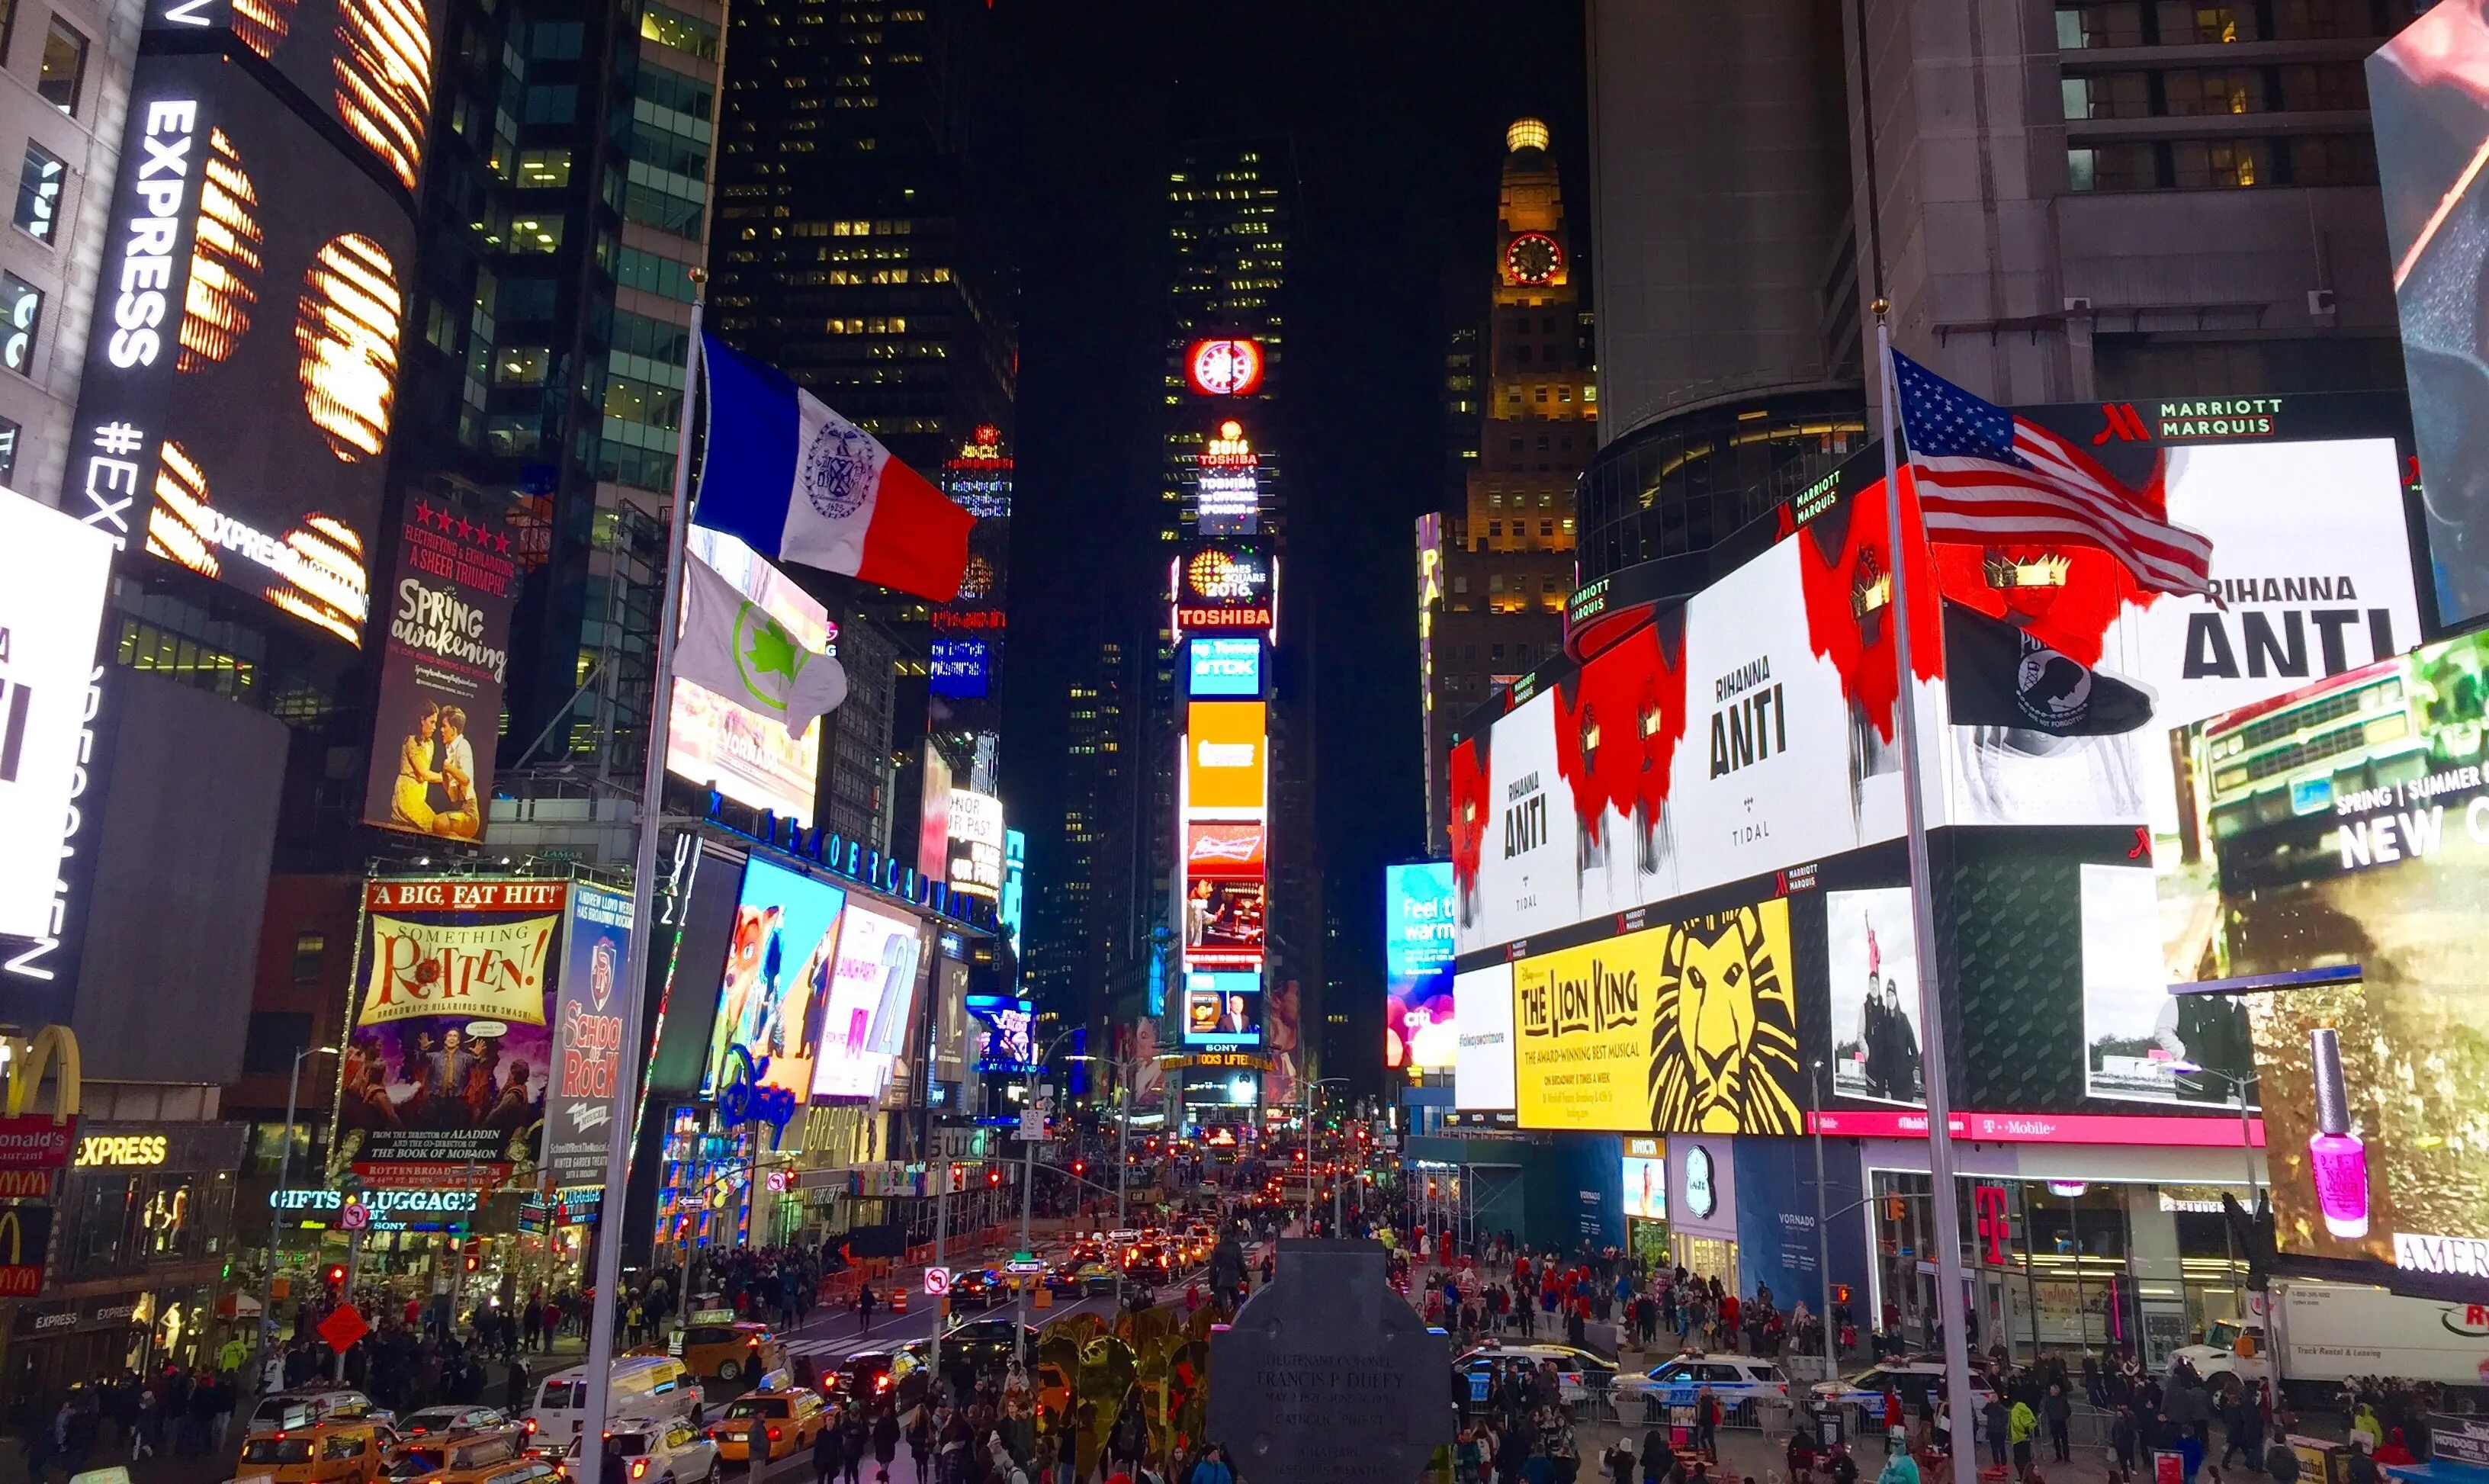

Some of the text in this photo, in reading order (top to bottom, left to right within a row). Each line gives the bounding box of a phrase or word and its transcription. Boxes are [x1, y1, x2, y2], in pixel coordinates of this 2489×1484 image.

[108, 100, 197, 368] EXPRESS
[2161, 399, 2282, 417] MARRIOTT
[2163, 418, 2271, 436] MARQUIS
[1209, 440, 1248, 455] 2016
[1200, 455, 1257, 464] TOSHIBA
[1200, 477, 1256, 490] TOSHIBA
[1797, 471, 1840, 508] MARRIOTT
[1797, 491, 1835, 524] MARQUIS
[409, 546, 417, 567] A
[420, 549, 453, 579] SHEER
[1225, 573, 1266, 582] SQUARE
[1570, 579, 1610, 609] MARRIOTT
[2205, 576, 2358, 603] RIHANNA
[398, 577, 483, 638] SPRING
[1571, 598, 1604, 624] MARQUIS
[1179, 609, 1270, 625] TOSHIBA
[391, 618, 507, 683] awakening
[2182, 608, 2396, 680] ANTI
[1716, 654, 1771, 704] RIHANNA
[1710, 682, 1786, 781] ANTI
[1508, 770, 1540, 803] RIHANNA
[2336, 766, 2481, 816] SPRING SUMMER
[950, 796, 979, 815] ONOR
[1505, 792, 1546, 860] ANTI
[1732, 821, 1770, 847] TIDAL
[2339, 805, 2443, 869] NEW
[544, 850, 583, 859] LAMAR
[1789, 863, 1818, 879] MARRIOTT
[849, 841, 974, 923] BROADWAY
[1790, 877, 1815, 891] MARQUIS
[452, 885, 497, 903] FAT
[1516, 894, 1537, 911] TIDAL
[602, 897, 617, 911] LLOYD
[618, 901, 633, 914] WEBB
[1404, 898, 1437, 919] Feel
[577, 907, 615, 925] HAS BROADWAY
[398, 925, 528, 944] SOMETHING
[1405, 923, 1454, 941] warm
[368, 929, 548, 1011] ROTTEN!
[1521, 959, 1638, 1038] THE LION KING
[377, 1003, 531, 1020] BROADWAY'S HILARIOUS NEW SMASH!
[562, 999, 622, 1050] SCHOO
[589, 1048, 601, 1060] OF
[1202, 1054, 1249, 1065] OCKS LIFTE
[1525, 1042, 1640, 1065] THE AWARD-WINNING BEST MUSICAL
[560, 1049, 618, 1098] ROCK
[1544, 1076, 1551, 1086] ON
[1552, 1074, 1575, 1085] BROADWAY
[1579, 1073, 1592, 1084] TIMES
[1593, 1073, 1597, 1084] A
[1597, 1072, 1611, 1083] WEEK
[450, 1130, 500, 1139] ALADDIN
[801, 1107, 859, 1153] FOREVER
[0, 1131, 66, 1148] onald's
[371, 1148, 498, 1158] THE BOOK OF MORMON
[554, 1155, 608, 1168] WINTER GARDEN THEATR
[270, 1190, 477, 1210] GIFTS LUGGAGE
[564, 1190, 600, 1203] LUGGAGE
[300, 1220, 326, 1229] Nikon
[1779, 1213, 1815, 1227] VORNADO
[2401, 1237, 2489, 1277] AMER
[36, 1312, 77, 1328] EXPRESS
[97, 1306, 134, 1320] EXPRESS
[1266, 1354, 1333, 1367] LIEUTENANT
[2298, 1347, 2317, 1355] Truck
[2319, 1347, 2343, 1356] Rental
[2353, 1349, 2381, 1359] Leasing
[1258, 1371, 1404, 1389] FRANCIS DUFFY
[1264, 1392, 1286, 1402] MAY
[1276, 1413, 1384, 1426] CATHOLIC PRIEST
[2435, 1434, 2479, 1451] HOTDOGS
